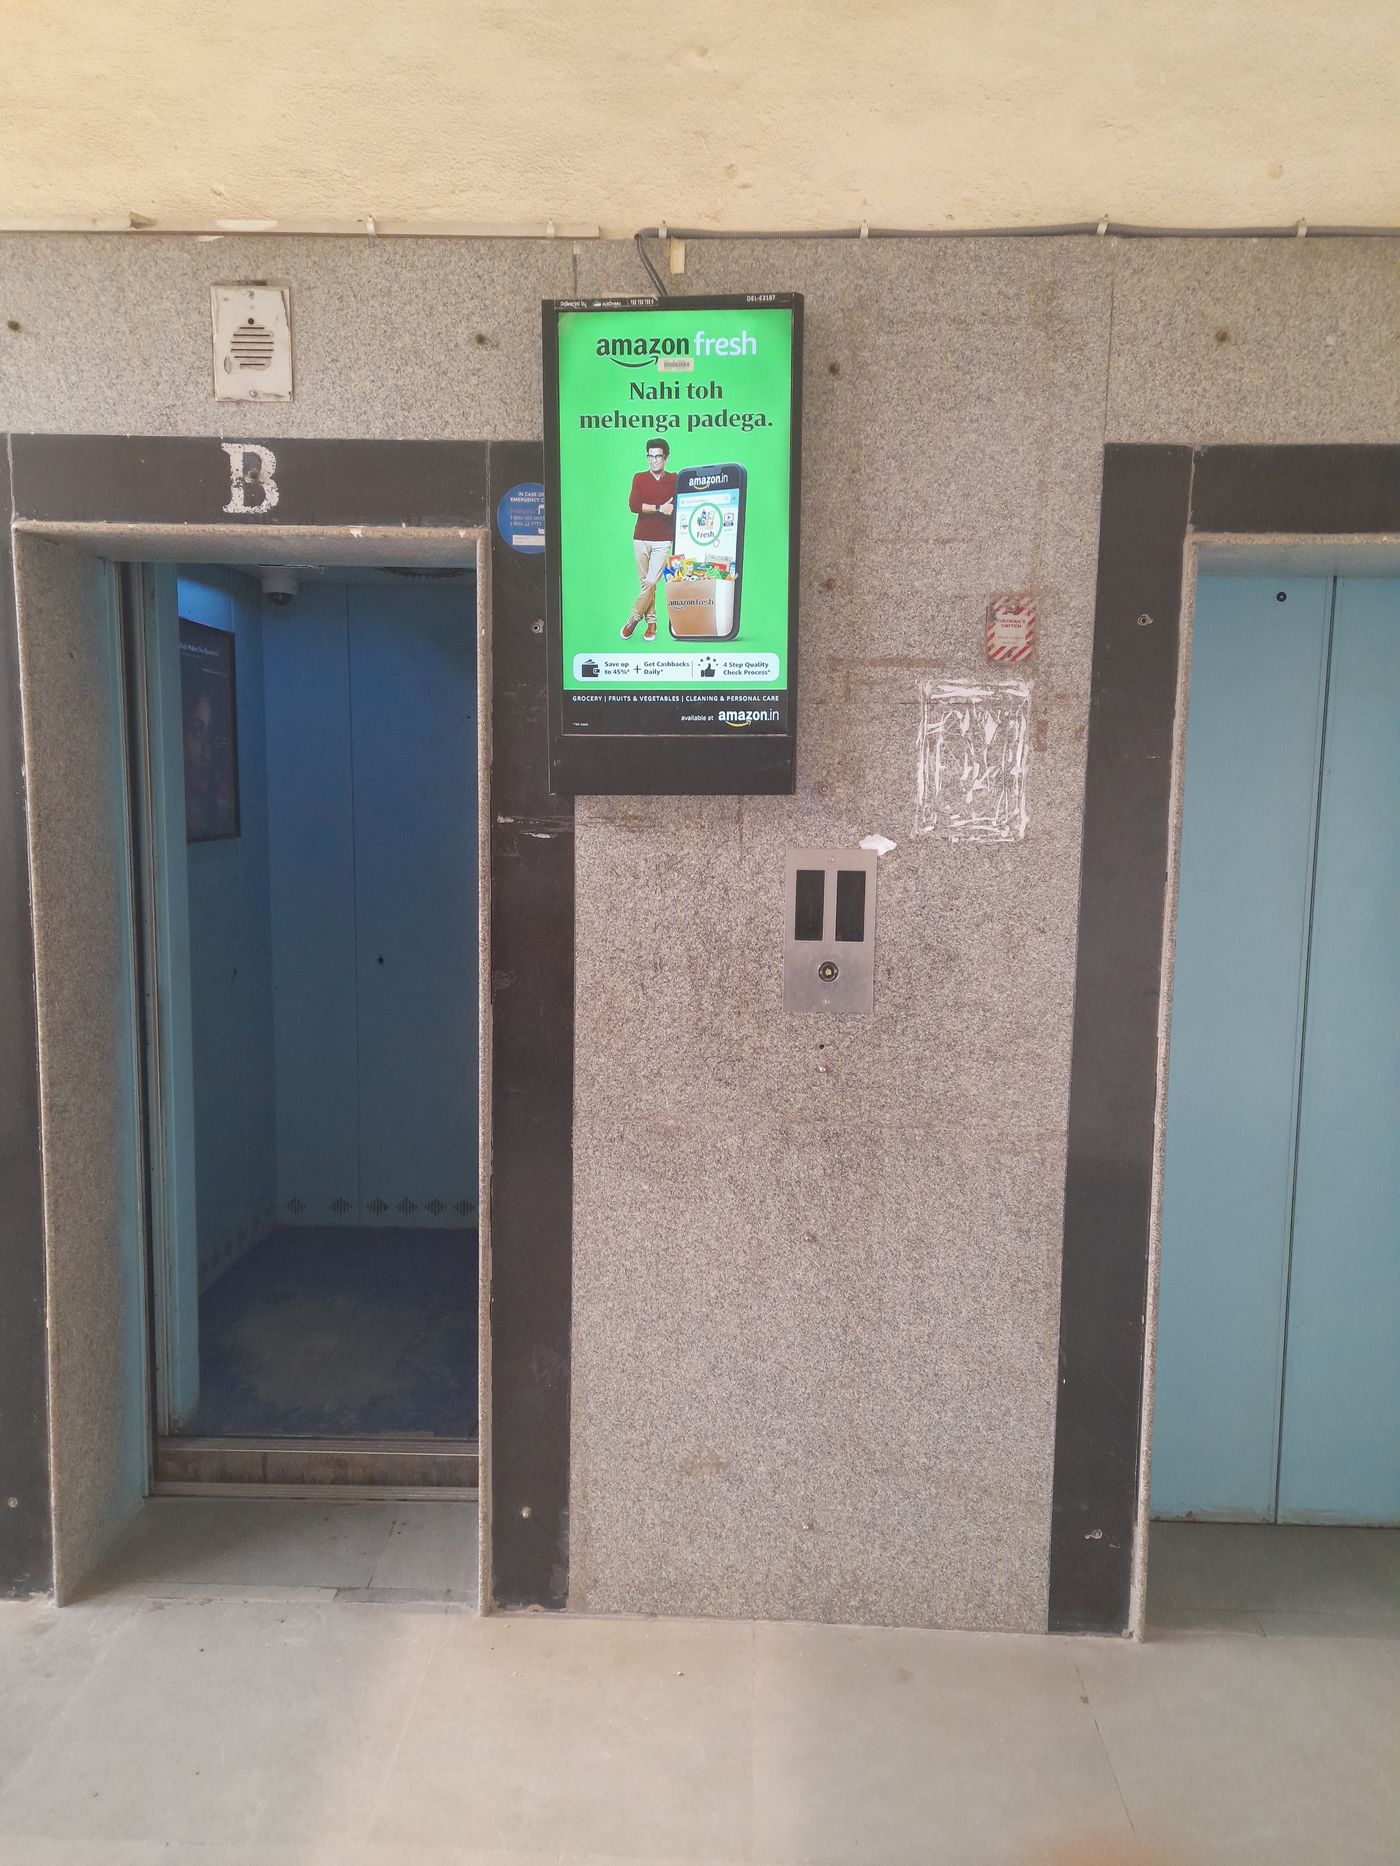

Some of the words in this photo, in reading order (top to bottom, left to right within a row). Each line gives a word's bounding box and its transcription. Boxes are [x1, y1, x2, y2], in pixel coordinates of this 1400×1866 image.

[596, 337, 690, 356] amazon
[694, 330, 756, 356] fresh
[629, 381, 680, 400] Nahi
[686, 381, 723, 400] toh
[580, 410, 680, 432] mehenga
[687, 409, 773, 432] padega.
[221, 442, 280, 514] B
[688, 472, 728, 487] amazon.in
[718, 708, 780, 721] amazon.in
